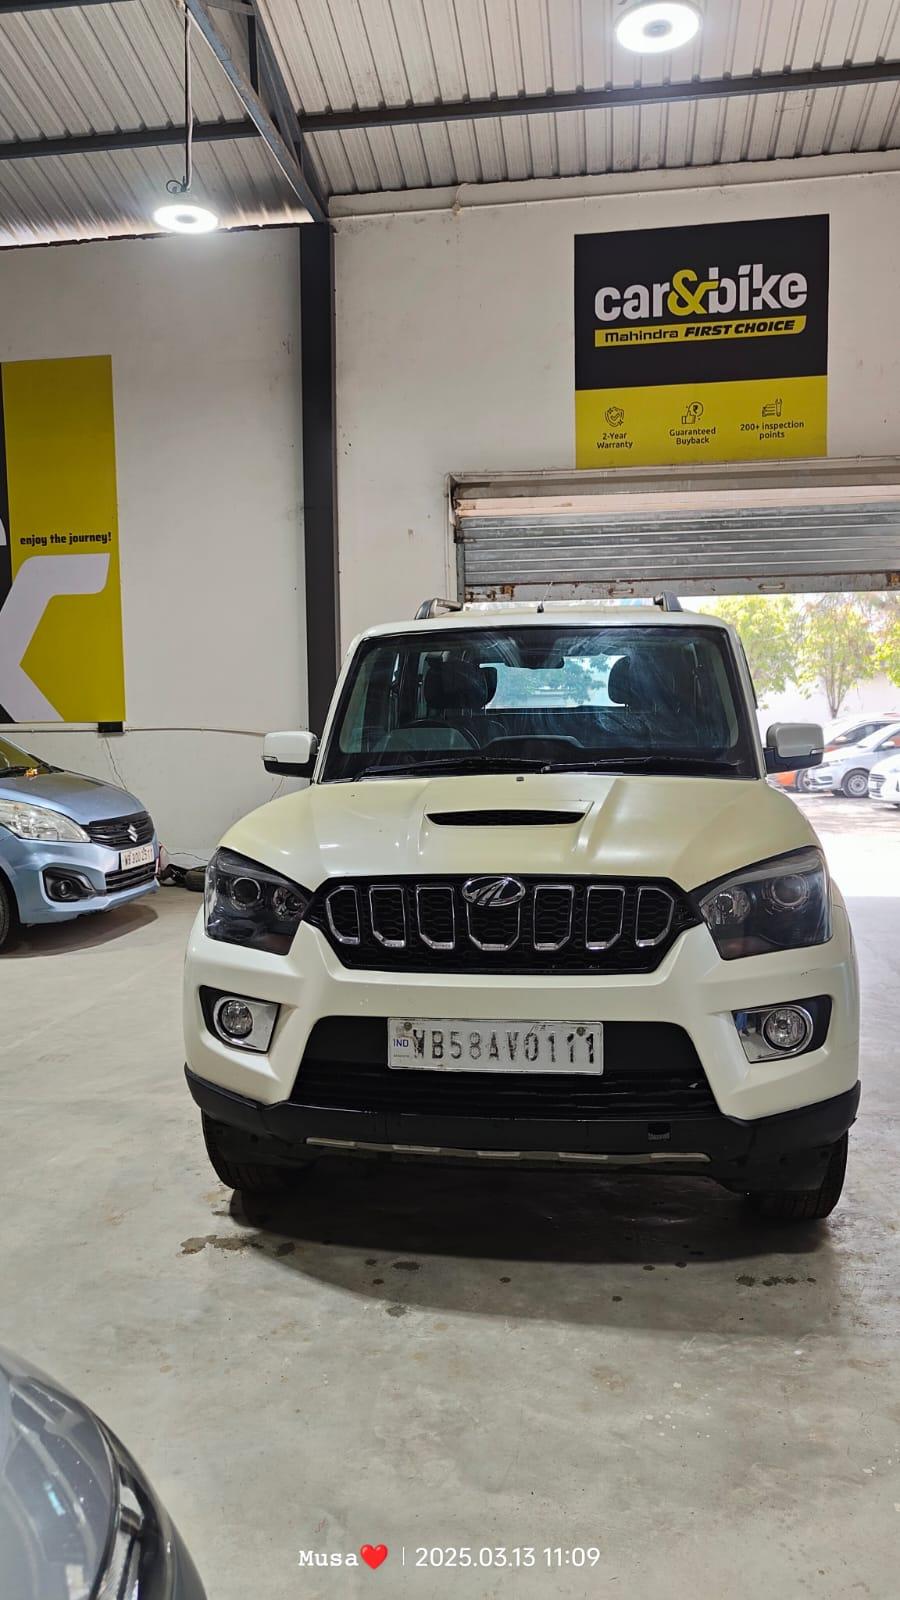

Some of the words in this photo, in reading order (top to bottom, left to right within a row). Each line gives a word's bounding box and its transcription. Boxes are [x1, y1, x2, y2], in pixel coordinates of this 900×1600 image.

[594, 263, 808, 322] car&bike
[604, 328, 679, 344] Mahindra
[684, 323, 733, 338] FIRST
[734, 319, 796, 335] CHOICE
[740, 422, 760, 432] 200+
[761, 420, 804, 431] inspection
[602, 432, 628, 441] 2-Year
[669, 427, 717, 436] Guaranteed
[759, 430, 785, 441] points
[596, 440, 633, 450] Warranty
[676, 436, 710, 445] Buyback
[20, 534, 47, 546] enjoy
[50, 533, 67, 544] the
[69, 532, 112, 545] journey!
[393, 1038, 409, 1048] IND
